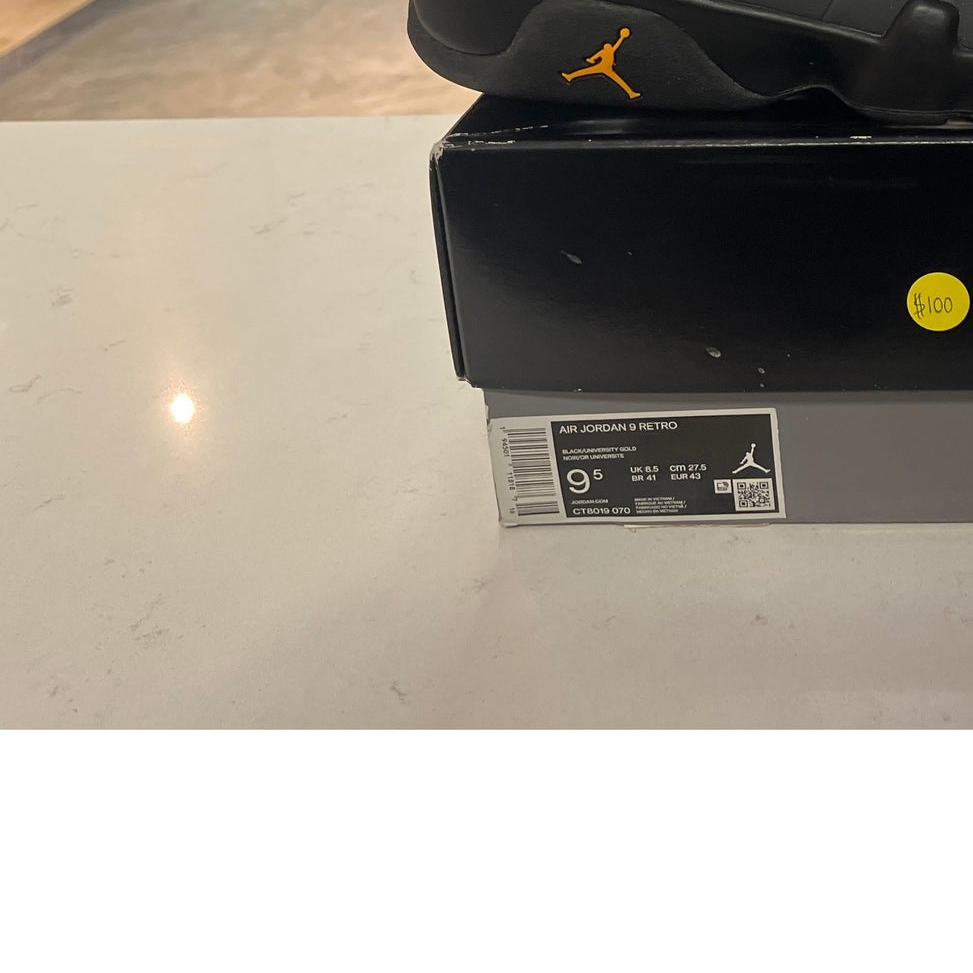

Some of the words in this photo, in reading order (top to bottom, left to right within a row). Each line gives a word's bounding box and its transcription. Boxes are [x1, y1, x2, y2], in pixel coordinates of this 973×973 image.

[914, 292, 953, 320] $100
[559, 424, 578, 434] AIR
[580, 423, 627, 433] JORDAN
[629, 422, 637, 431] 9
[639, 421, 678, 431] RETRO
[645, 465, 659, 473] 8.5
[669, 464, 686, 472] cm
[689, 472, 701, 480] 43
[573, 507, 609, 515] CT8019
